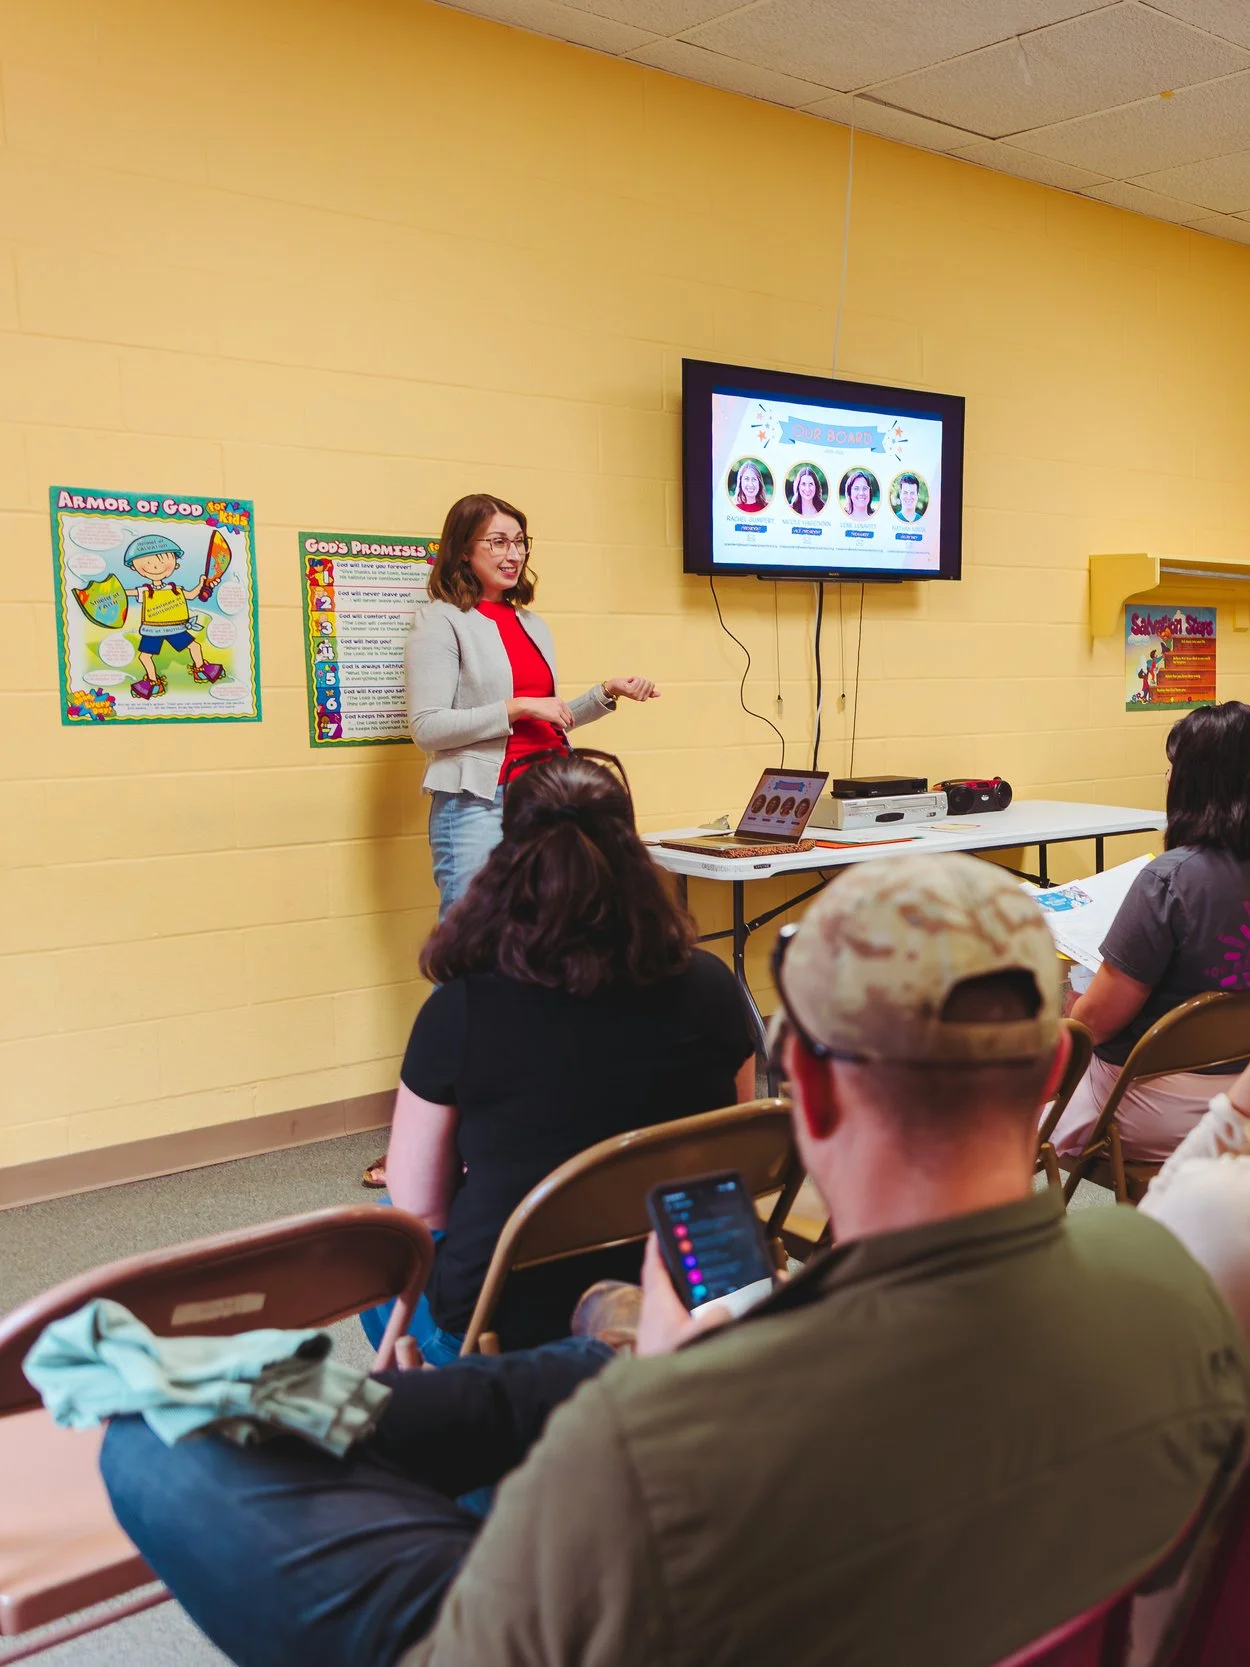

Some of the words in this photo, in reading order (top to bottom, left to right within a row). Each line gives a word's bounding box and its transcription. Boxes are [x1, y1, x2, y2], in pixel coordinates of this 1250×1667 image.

[792, 423, 823, 440] OUR
[827, 428, 873, 445] BOARD
[58, 490, 131, 512] ARMOR
[136, 499, 159, 514] OF
[162, 499, 203, 517] GOD
[217, 510, 248, 527] Kids
[304, 538, 349, 554] GOD'S
[350, 540, 427, 558] PROMISES
[323, 570, 329, 584] 1
[321, 596, 332, 609] 2
[322, 621, 333, 635] 3
[1131, 612, 1182, 636] Salvation
[1185, 613, 1213, 637] Steps
[321, 646, 334, 660] 4
[326, 672, 336, 685] 5
[326, 698, 338, 710] 6
[327, 724, 338, 736] 7
